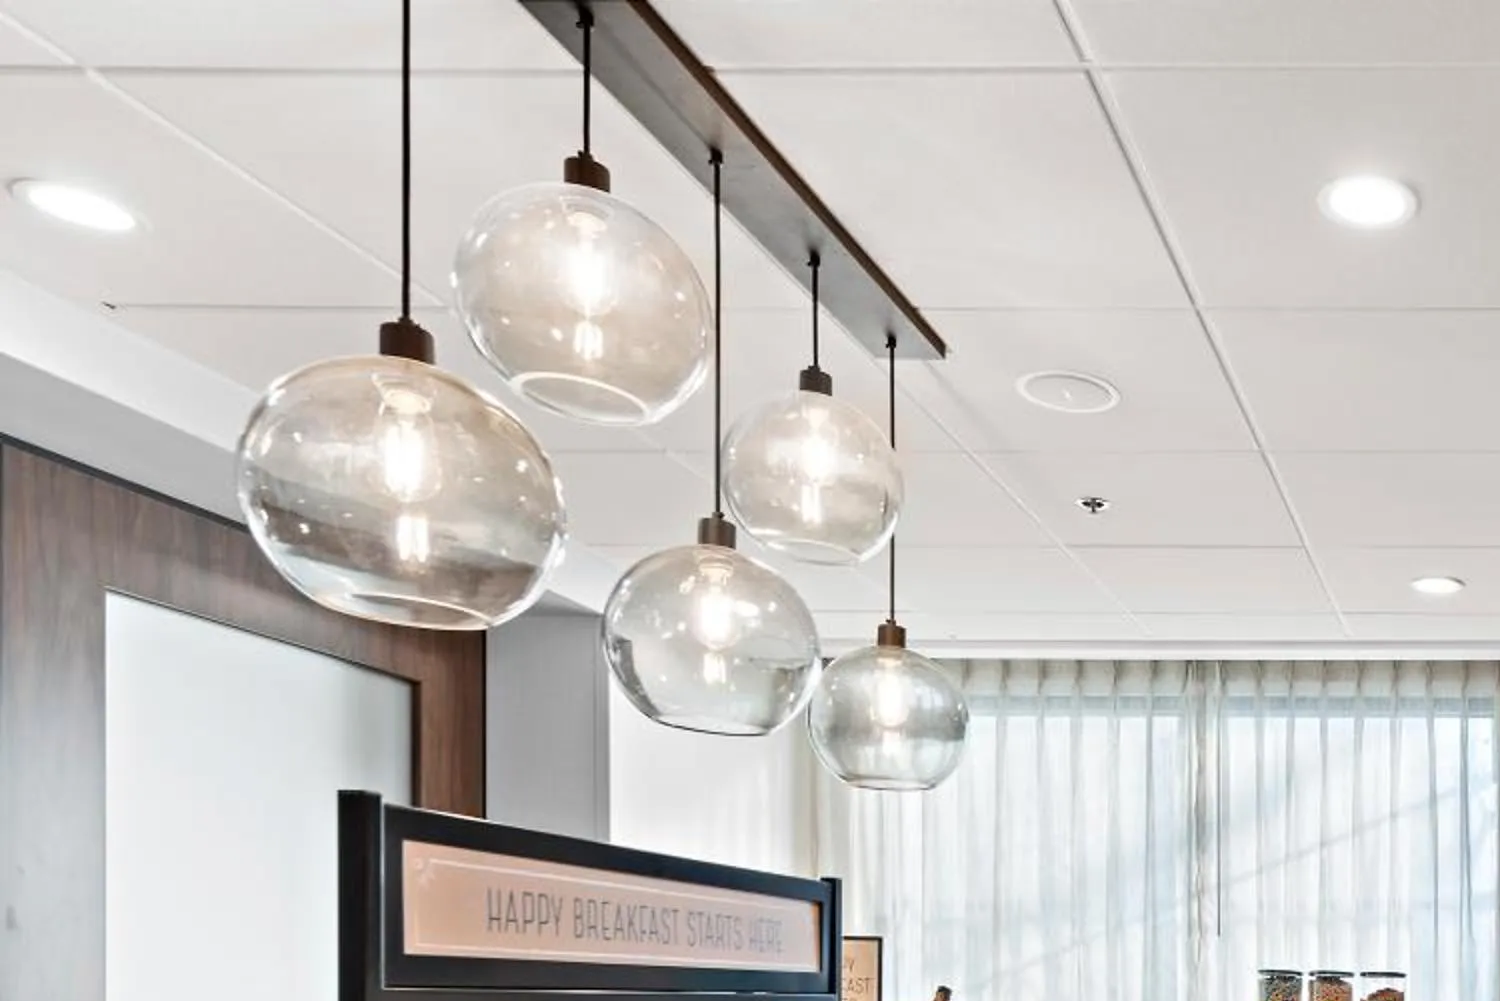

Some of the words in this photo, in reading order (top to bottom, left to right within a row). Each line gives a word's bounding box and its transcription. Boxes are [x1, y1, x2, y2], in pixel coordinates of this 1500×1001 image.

[486, 887, 563, 937] HAPPY
[573, 896, 680, 947] BREAKFAST
[687, 909, 743, 951] STARTS
[750, 916, 783, 954] HERE
